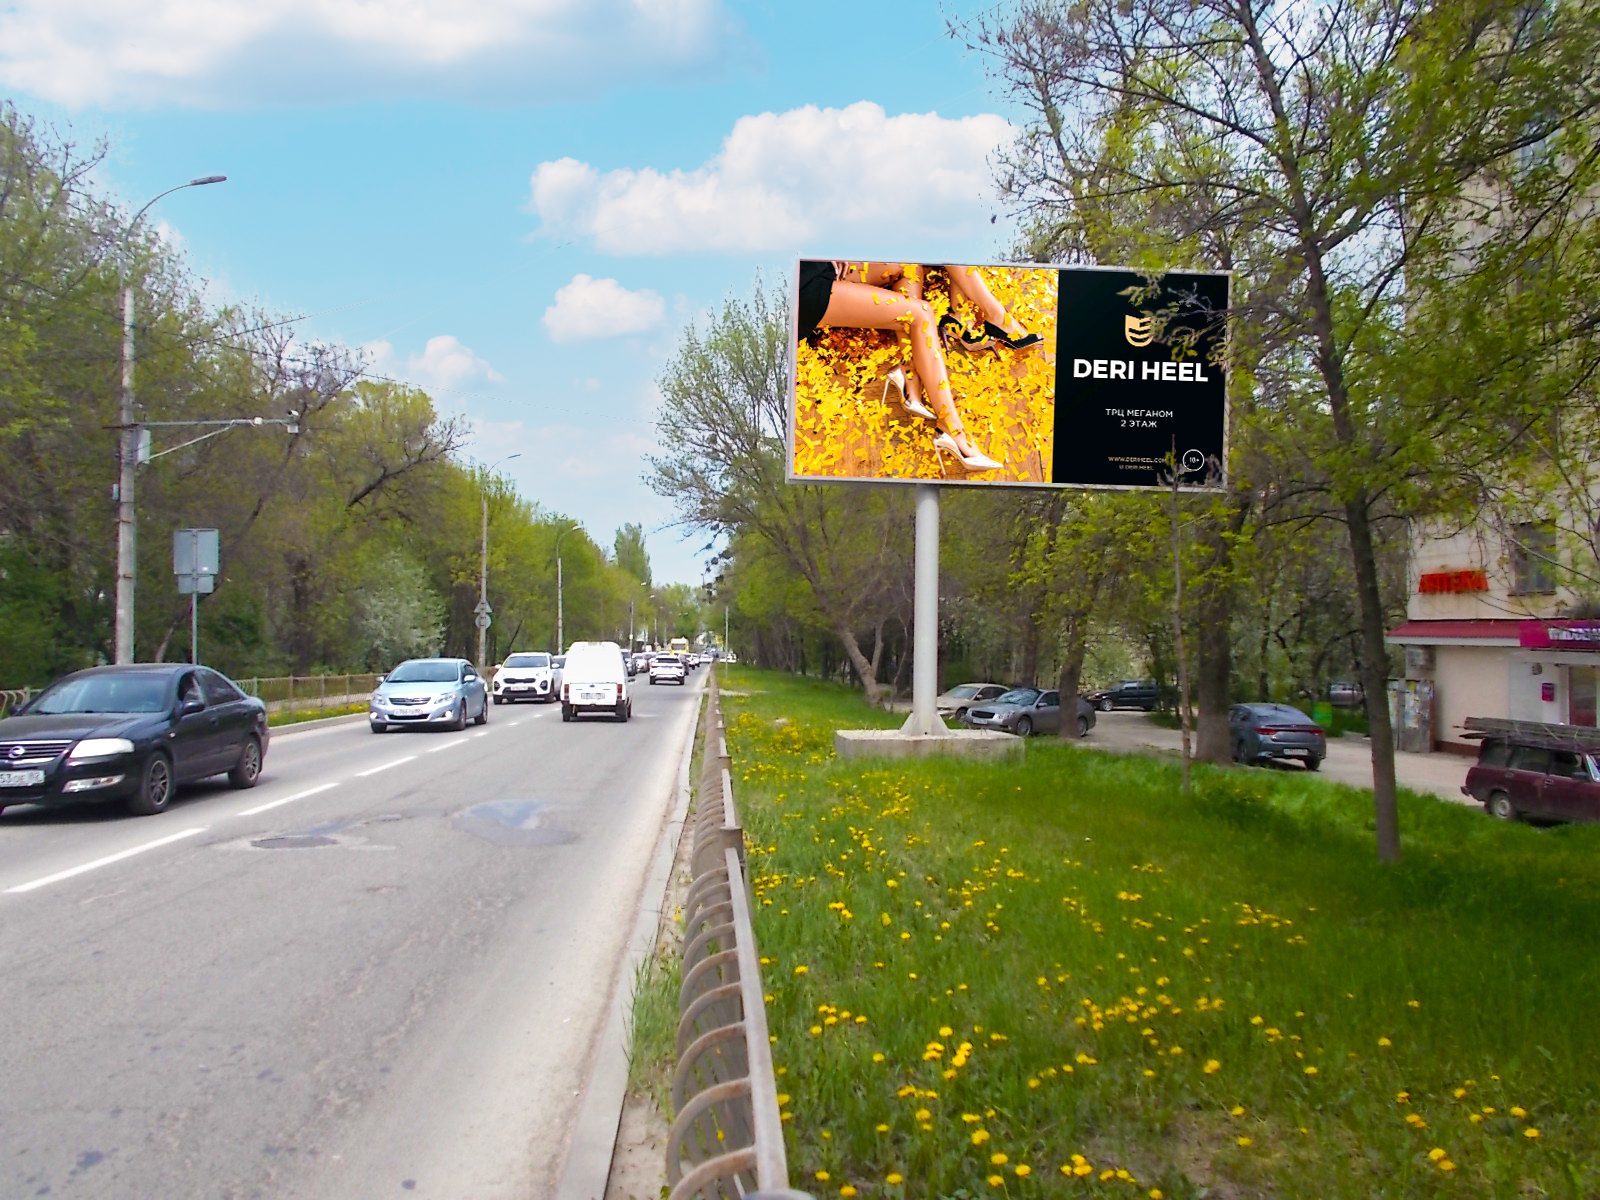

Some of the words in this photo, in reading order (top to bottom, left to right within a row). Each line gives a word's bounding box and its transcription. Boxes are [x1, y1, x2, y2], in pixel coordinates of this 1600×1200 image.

[1073, 358, 1135, 380] DERI
[1141, 361, 1209, 382] HEEL
[1105, 408, 1125, 417] ТРЦ
[1127, 409, 1174, 418] МЕГАНОМ
[1120, 419, 1127, 428] 2
[1129, 420, 1158, 428] ЭТАЖ
